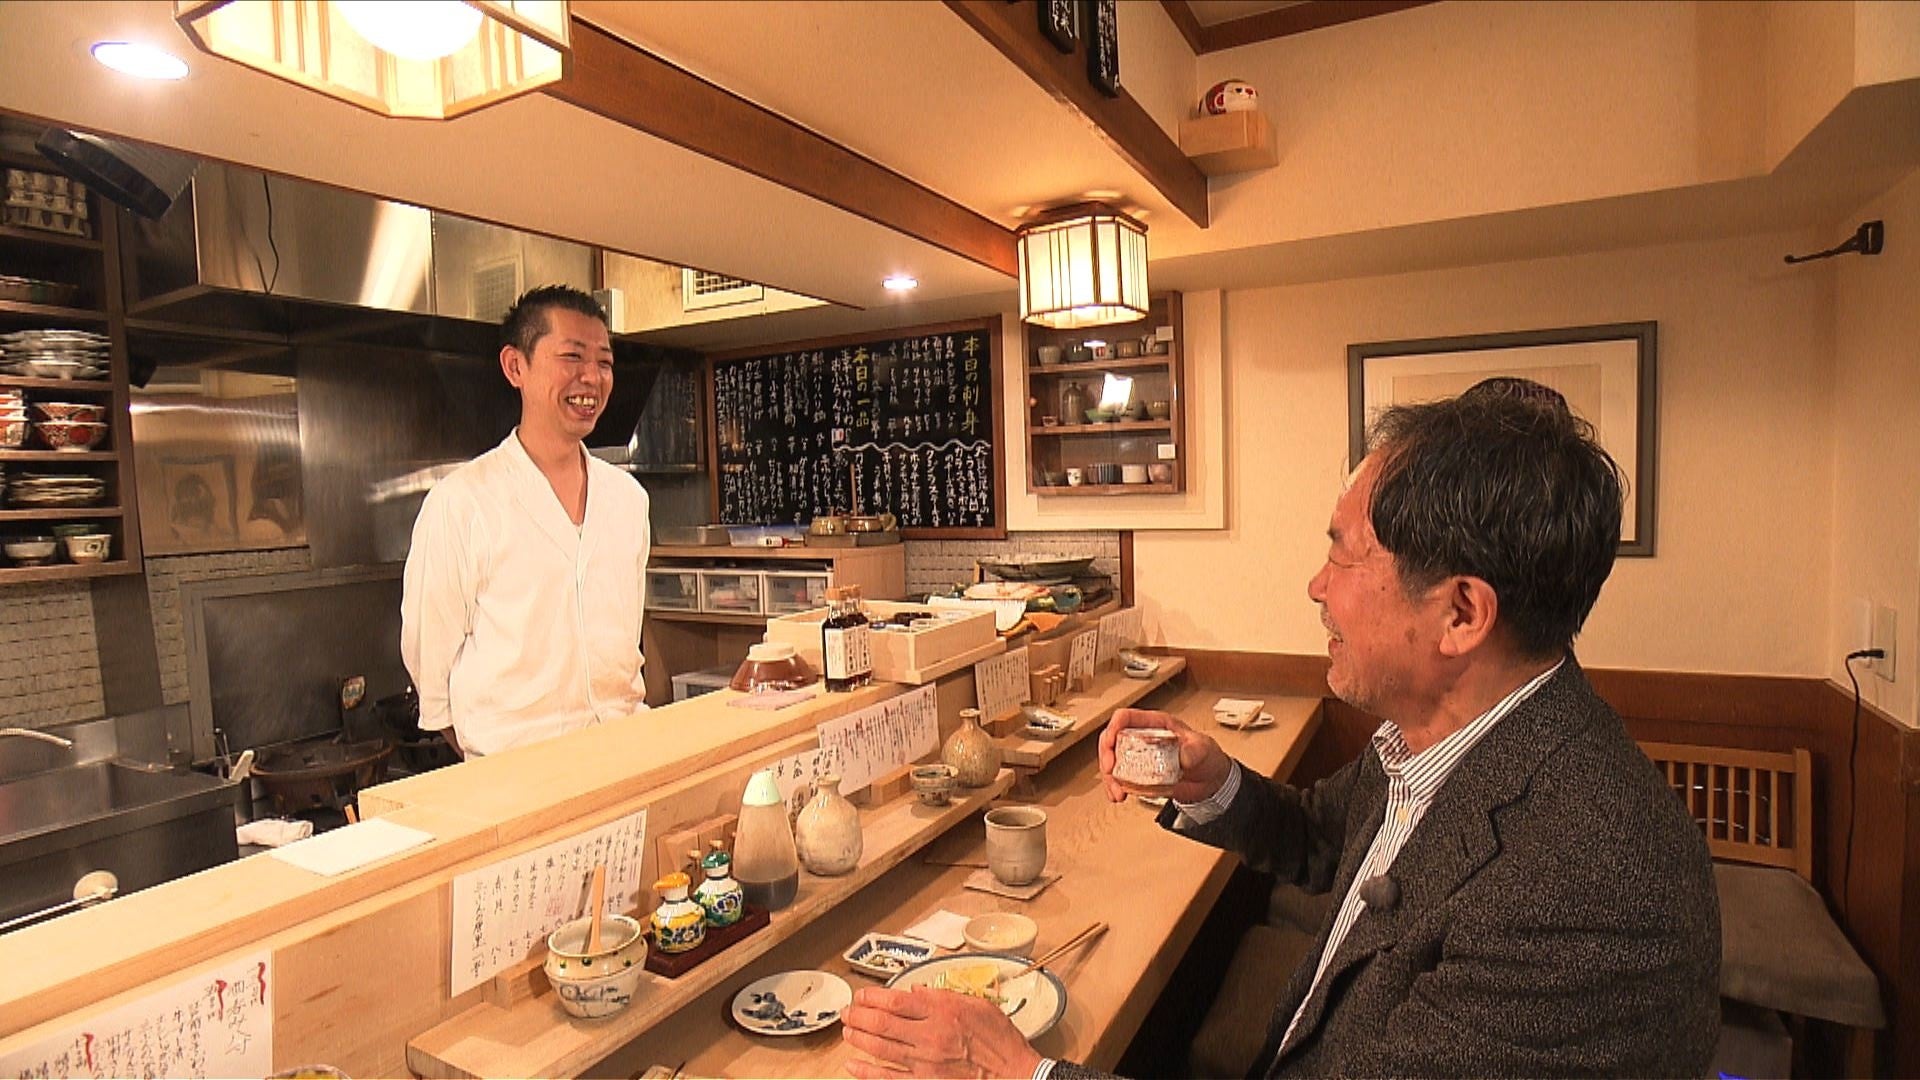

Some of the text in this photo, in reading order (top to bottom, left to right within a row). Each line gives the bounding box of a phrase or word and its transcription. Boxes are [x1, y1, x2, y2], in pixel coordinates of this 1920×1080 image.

[852, 345, 870, 428] 本日の一品
[961, 335, 980, 435] 本日の刺身
